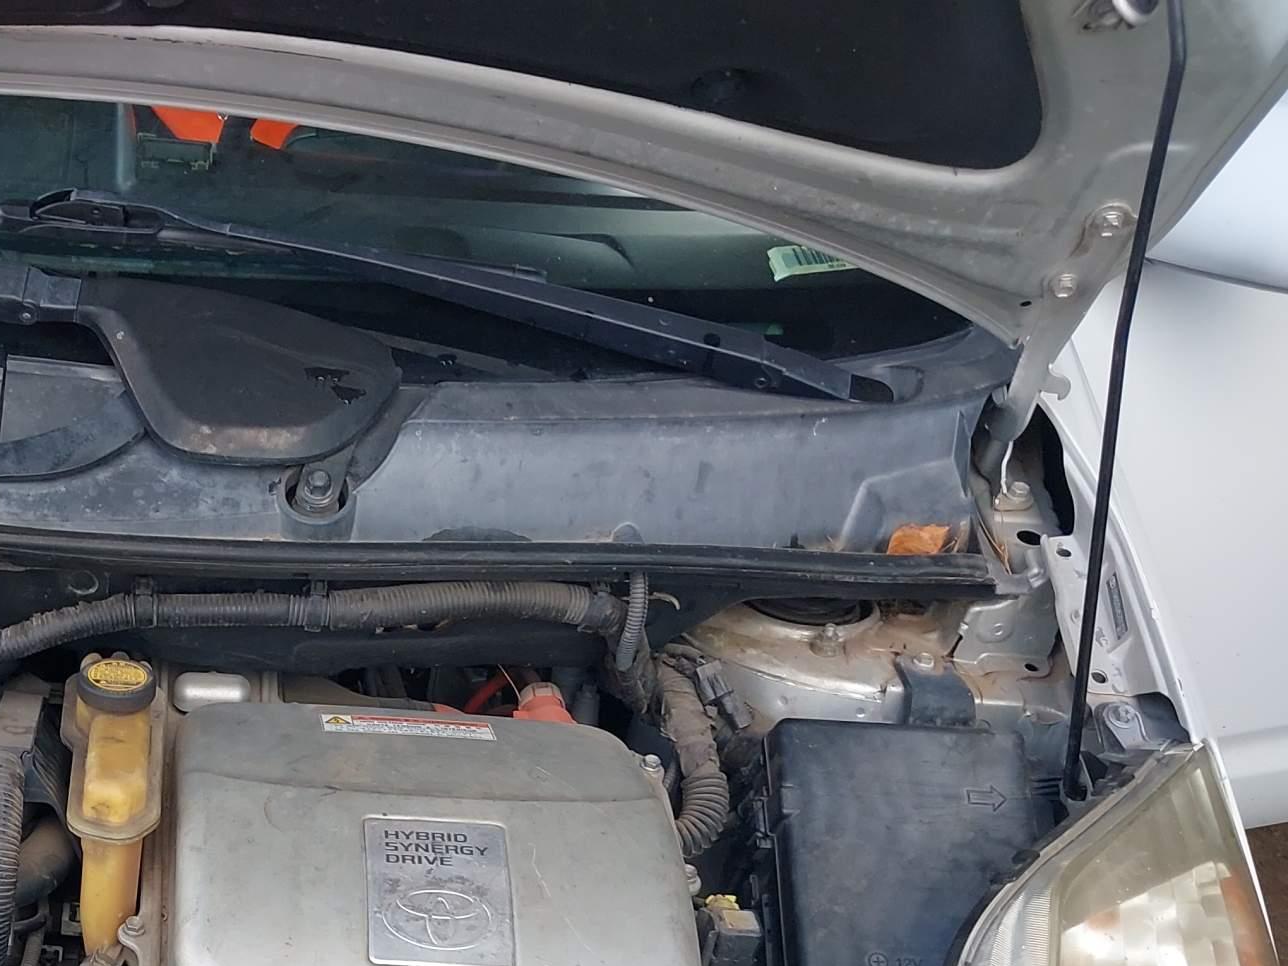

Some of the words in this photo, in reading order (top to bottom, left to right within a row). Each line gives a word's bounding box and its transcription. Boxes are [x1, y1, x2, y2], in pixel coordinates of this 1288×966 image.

[384, 830, 468, 843] HYBRID
[385, 841, 488, 856] SYNERGY
[385, 853, 453, 867] DRIVE
